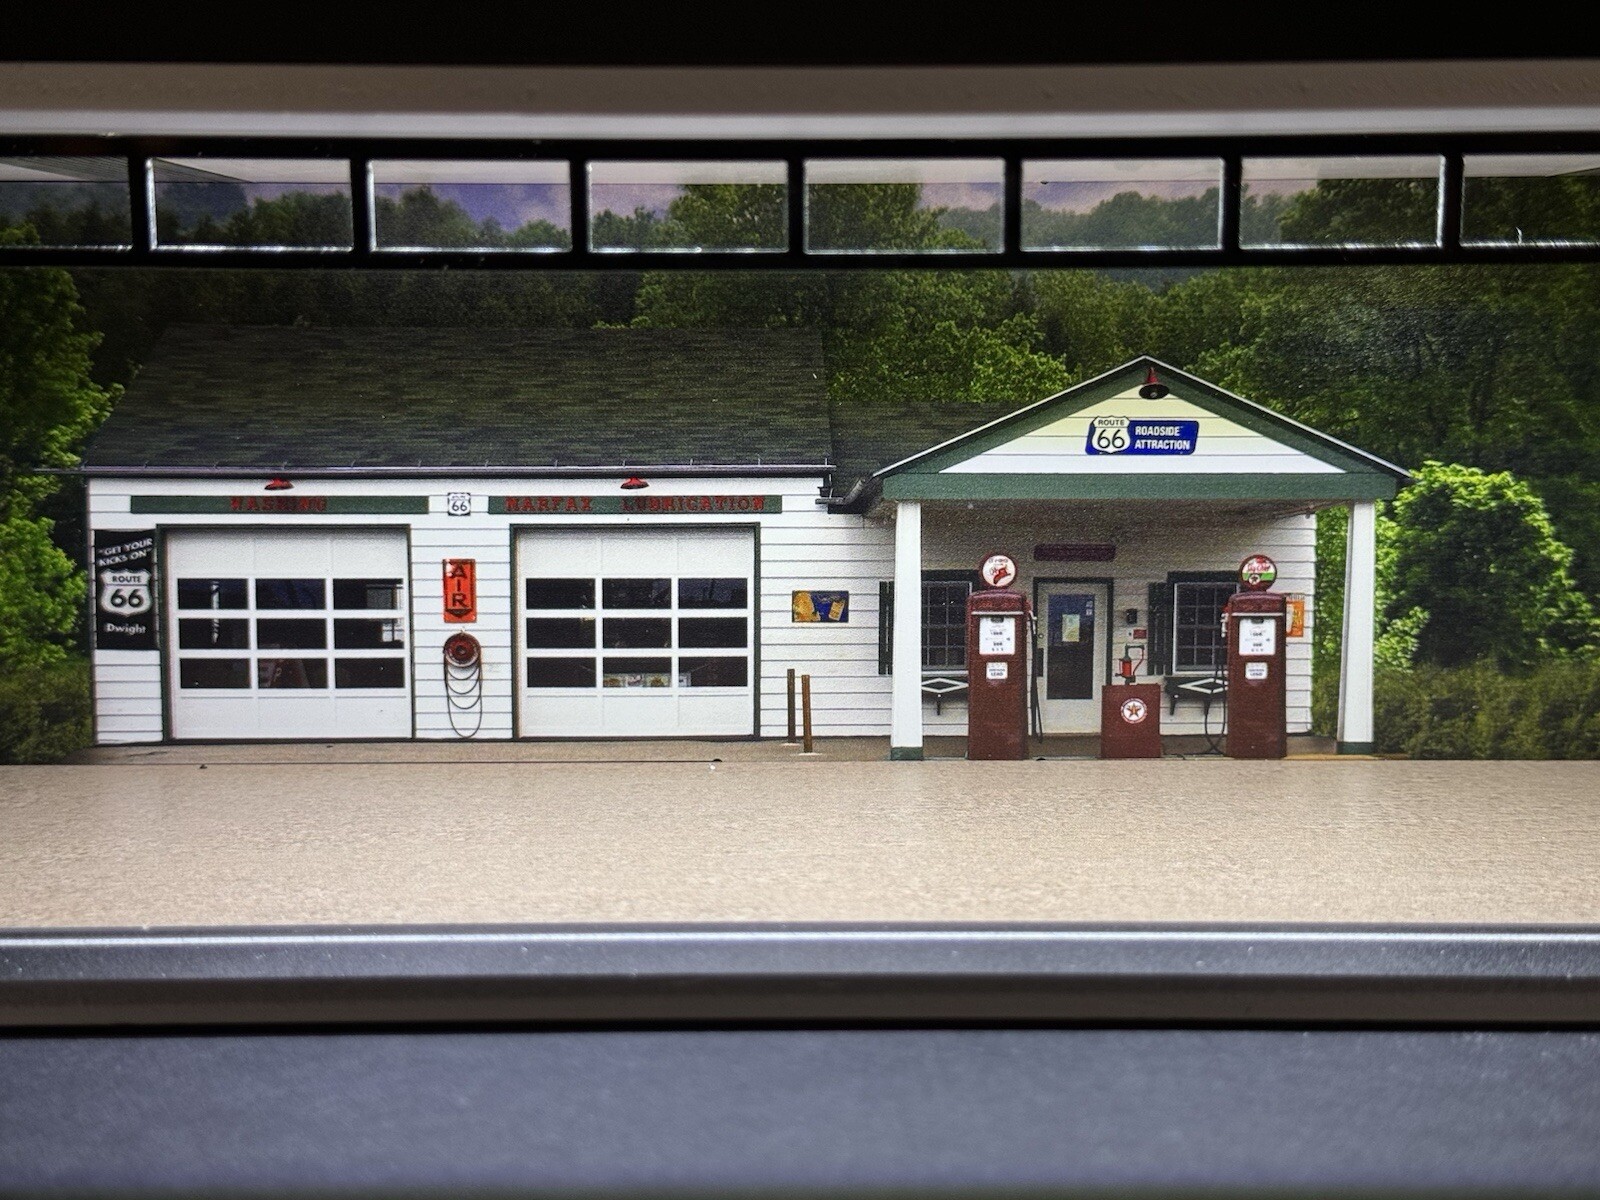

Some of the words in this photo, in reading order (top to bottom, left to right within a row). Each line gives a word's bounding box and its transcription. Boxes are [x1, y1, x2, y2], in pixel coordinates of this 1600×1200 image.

[1098, 419, 1125, 427] ROUTE
[1135, 425, 1180, 436] ROADSIDE
[1097, 429, 1125, 449] 66
[1134, 440, 1190, 450] ATTRACTION
[451, 500, 468, 511] 66
[622, 496, 764, 511] LUBRICATION
[124, 538, 153, 552] YOUR
[98, 555, 128, 567] KICKS
[112, 575, 142, 583] ROUTE
[450, 563, 469, 607] AIR
[110, 588, 144, 608] 66
[106, 623, 146, 636] Dwight
